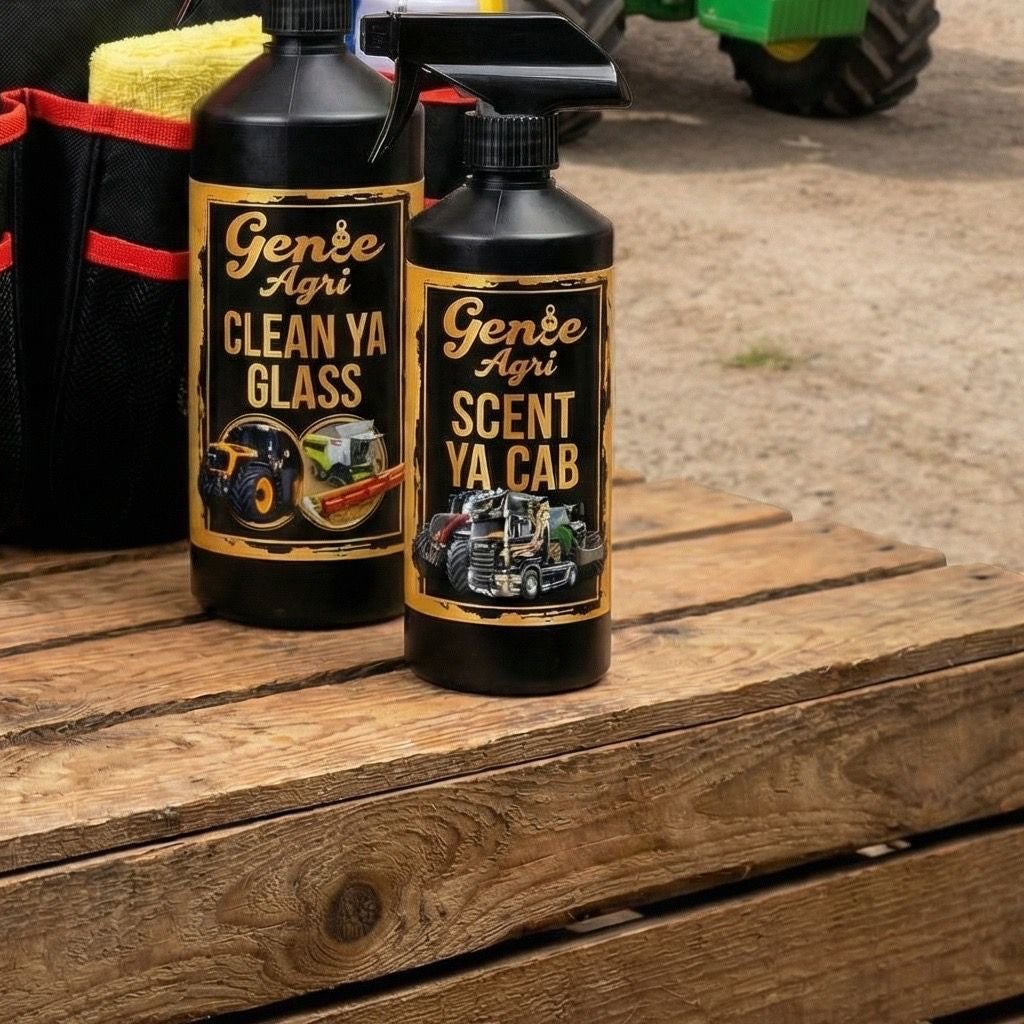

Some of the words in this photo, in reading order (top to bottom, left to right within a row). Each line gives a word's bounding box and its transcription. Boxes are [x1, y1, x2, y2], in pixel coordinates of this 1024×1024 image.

[226, 211, 385, 279] Genie
[260, 265, 351, 305] Agri
[224, 311, 335, 358] CLEAN
[346, 311, 386, 357] YA
[443, 297, 587, 360] Genie
[248, 363, 361, 409] GLASS
[475, 351, 557, 386] Agri
[452, 390, 575, 439] SCENT
[446, 441, 492, 490] YA
[506, 440, 579, 492] CAB
